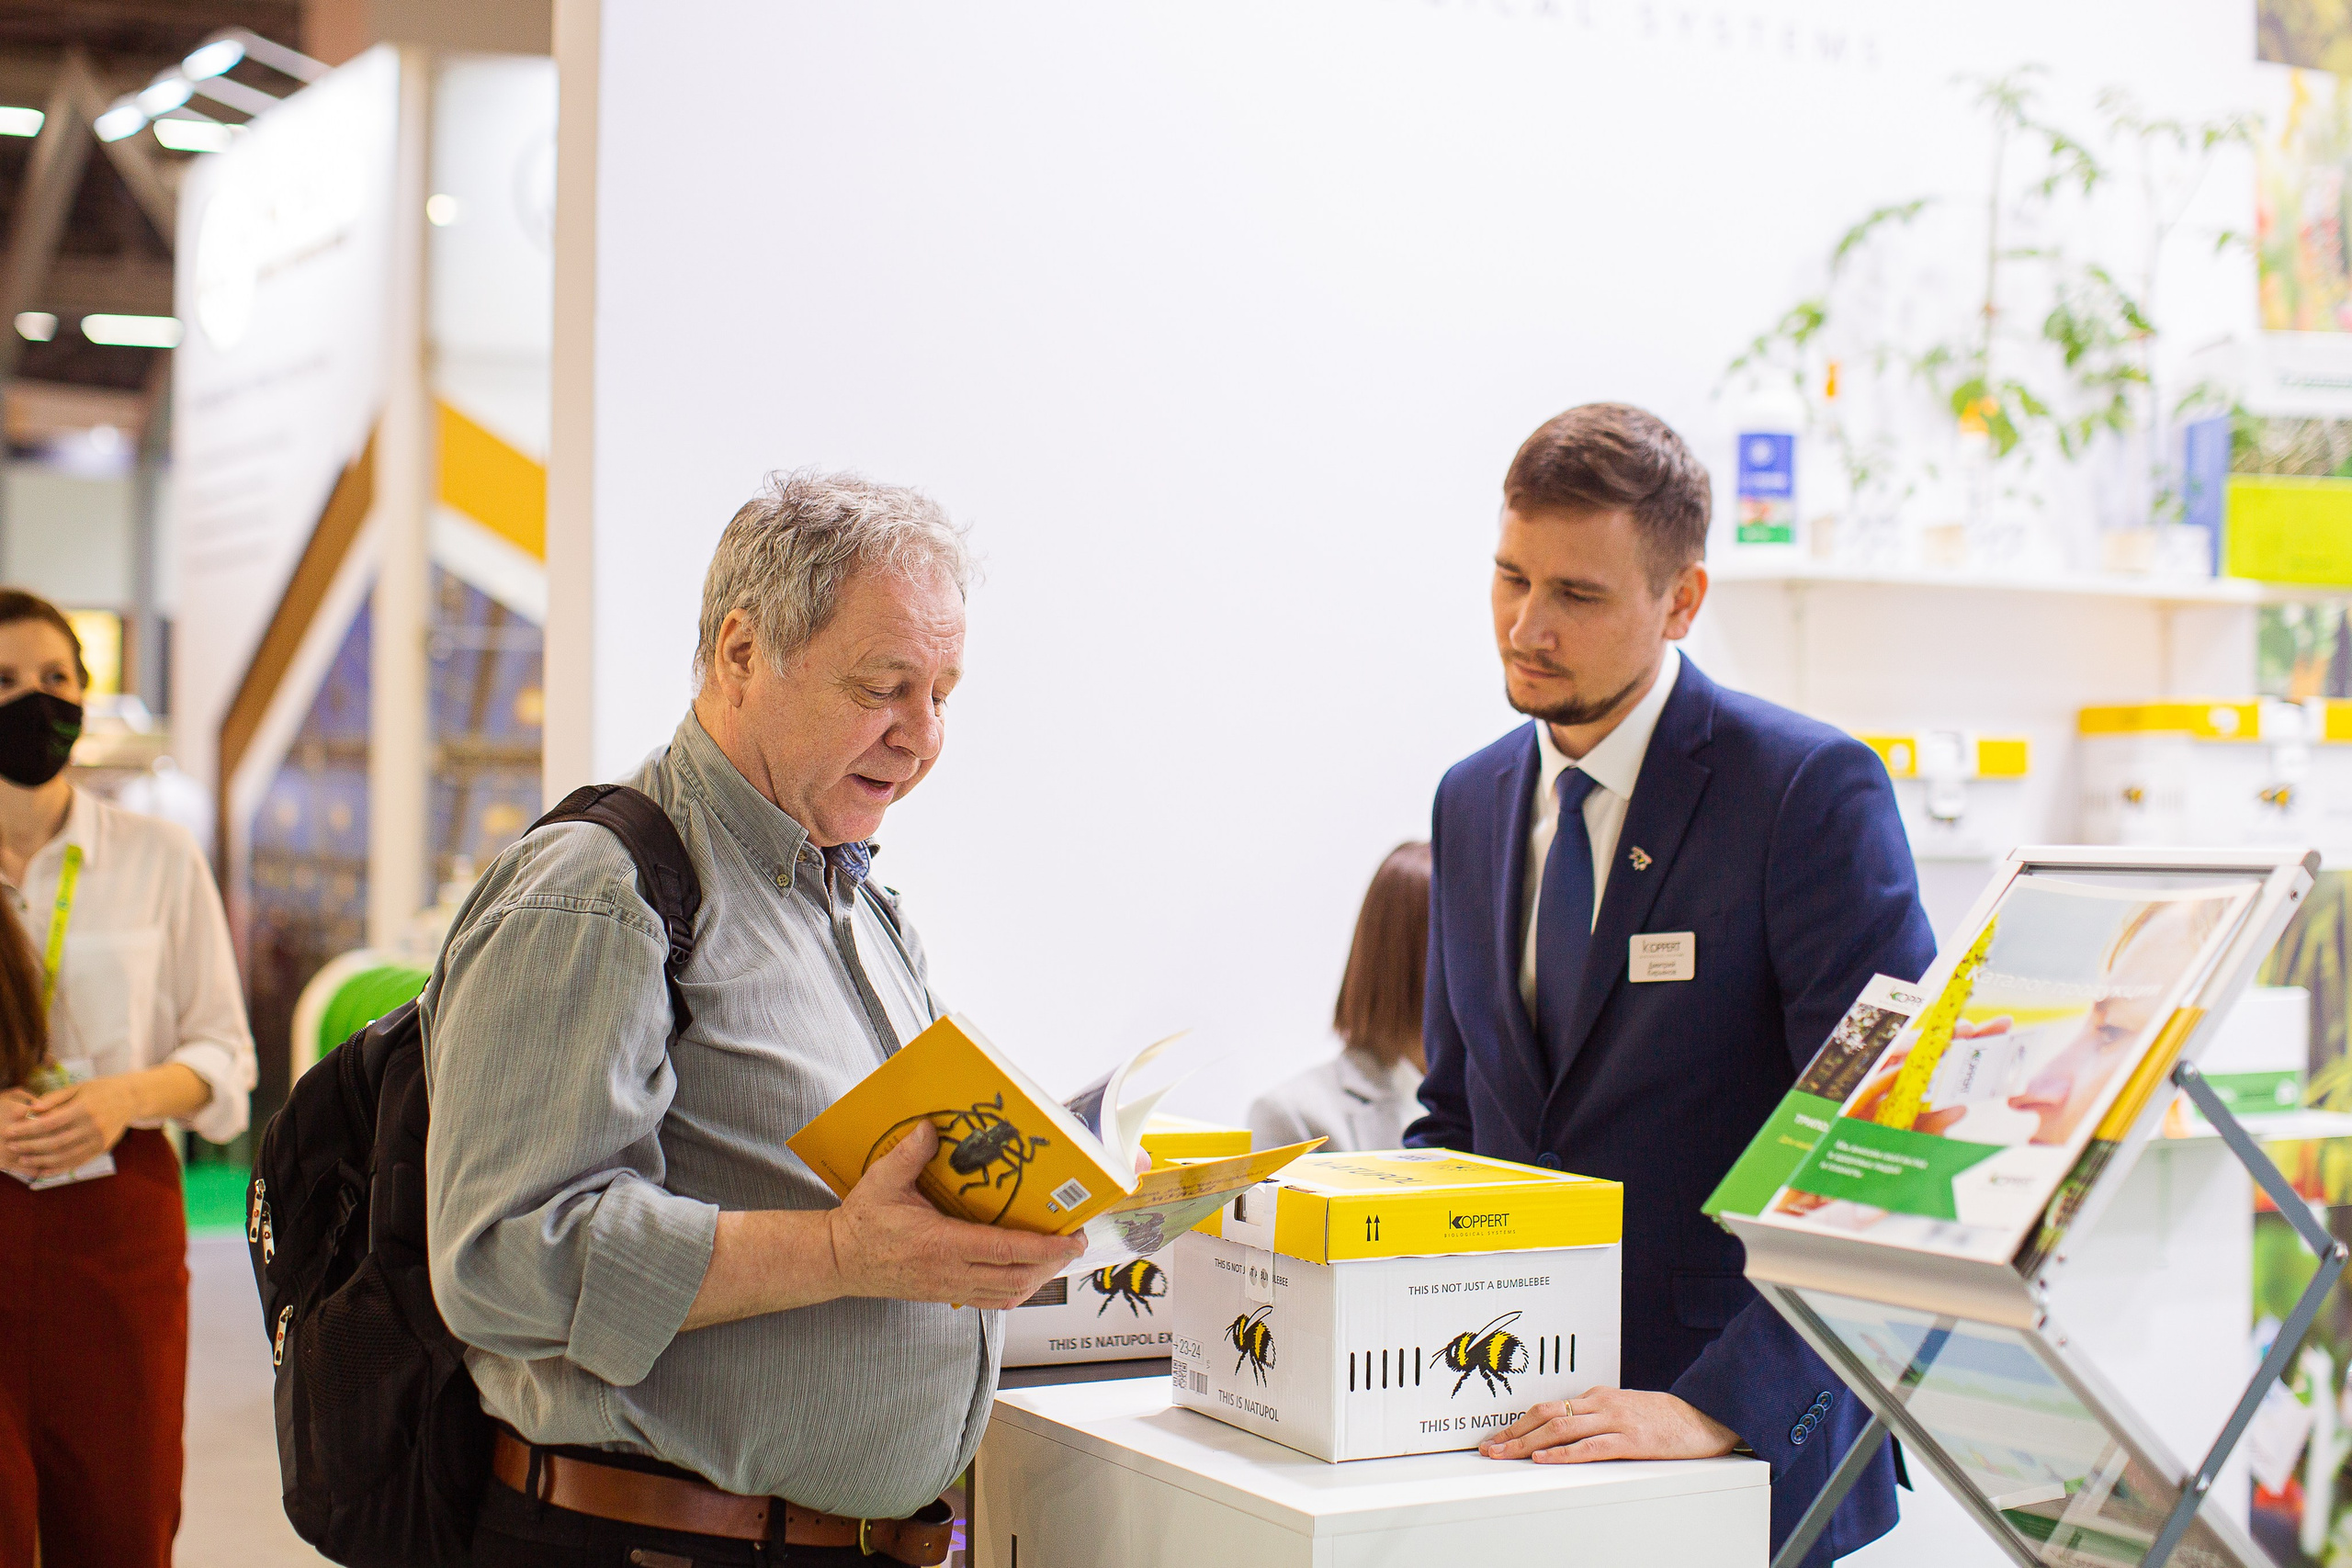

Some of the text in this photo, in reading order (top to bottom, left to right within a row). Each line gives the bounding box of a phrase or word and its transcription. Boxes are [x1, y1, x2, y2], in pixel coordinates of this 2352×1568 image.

[1889, 986, 1924, 1006] KOPP
[1449, 1210, 1510, 1229] KOPPERT
[1215, 1258, 1226, 1269] THIS
[1231, 1262, 1242, 1273] NOT
[1408, 1276, 1550, 1295] THIS IS NOT JUST A BUMBLEBEE
[1048, 1338, 1077, 1350] THIS
[1080, 1337, 1091, 1348] IS
[1096, 1333, 1155, 1348] NATUPOL
[1180, 1338, 1201, 1359] 23-24
[1218, 1389, 1279, 1422] THIS IS NATUPOL
[1419, 1411, 1526, 1433] THIS IS NATUP
